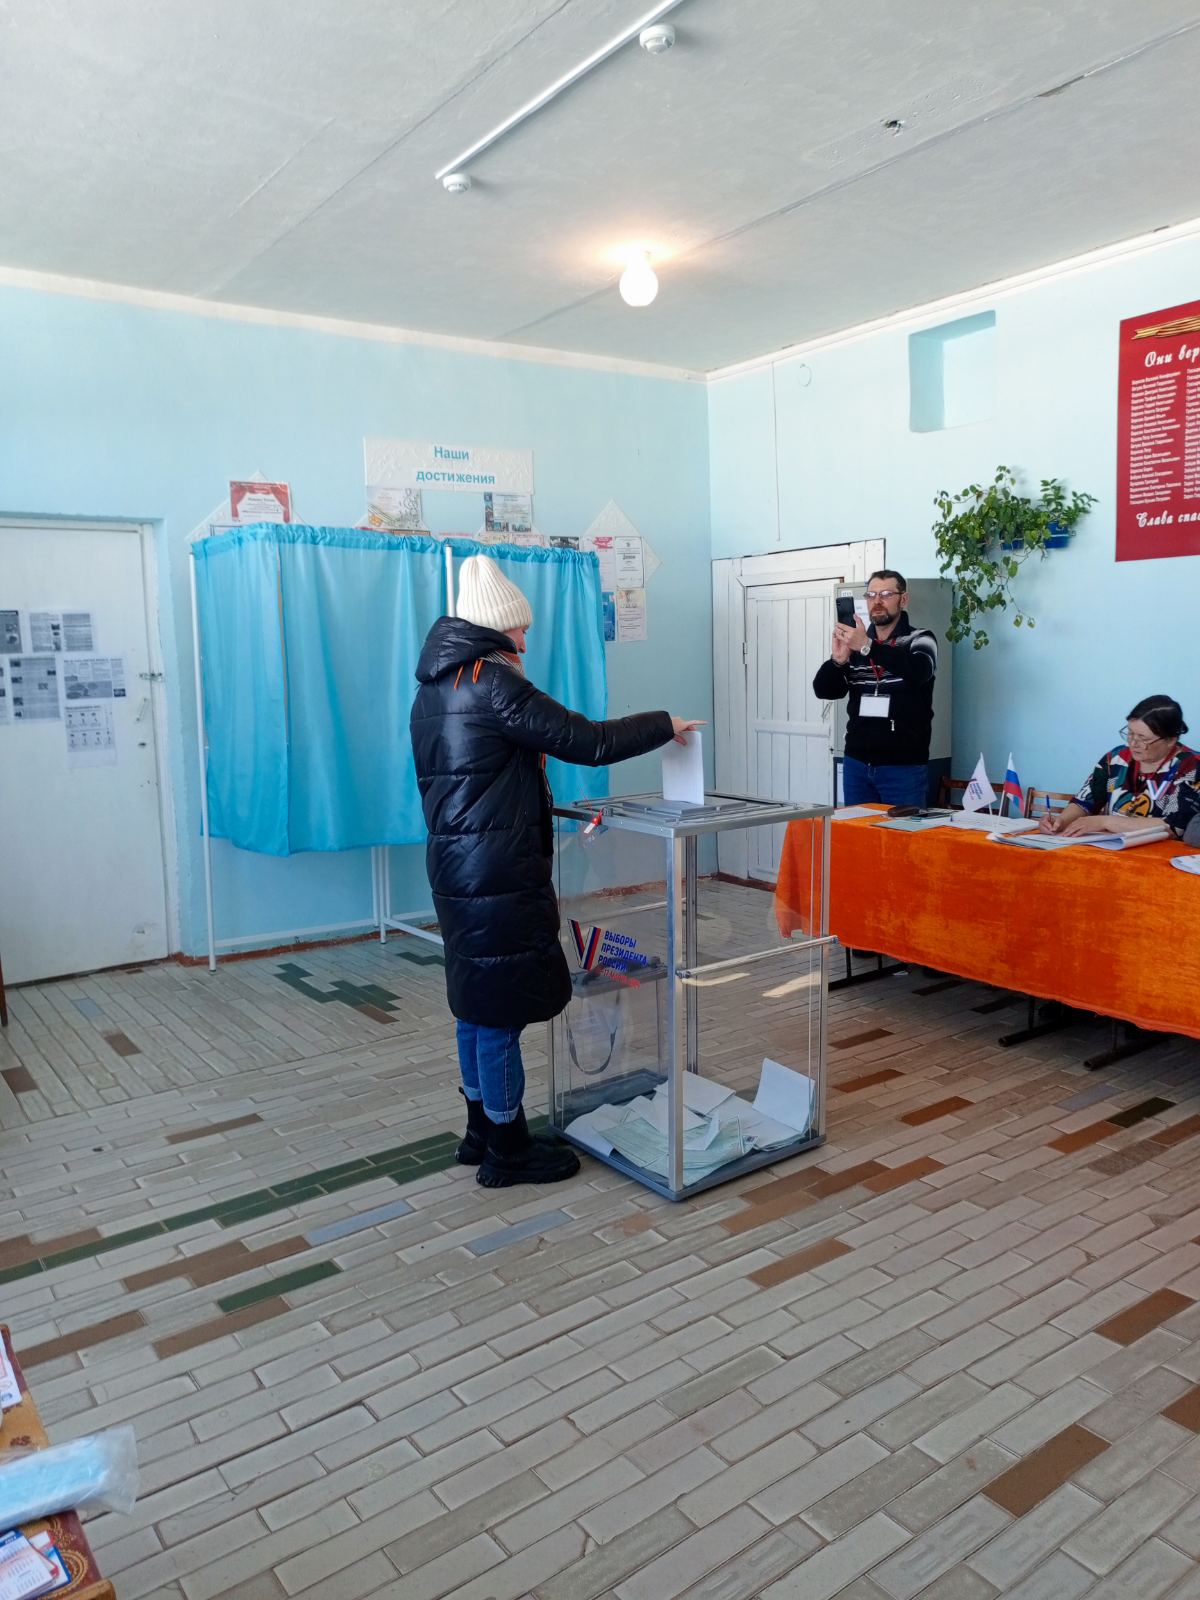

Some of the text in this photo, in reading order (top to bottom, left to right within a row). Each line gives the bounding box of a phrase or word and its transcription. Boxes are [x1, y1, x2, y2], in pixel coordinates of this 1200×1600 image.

[434, 445, 469, 460] Наши
[416, 470, 495, 485] достижения
[1136, 510, 1173, 528] Слава
[604, 930, 636, 949] ВЫБОРЫ
[601, 942, 648, 966] ПРЕЗИДЕНТА
